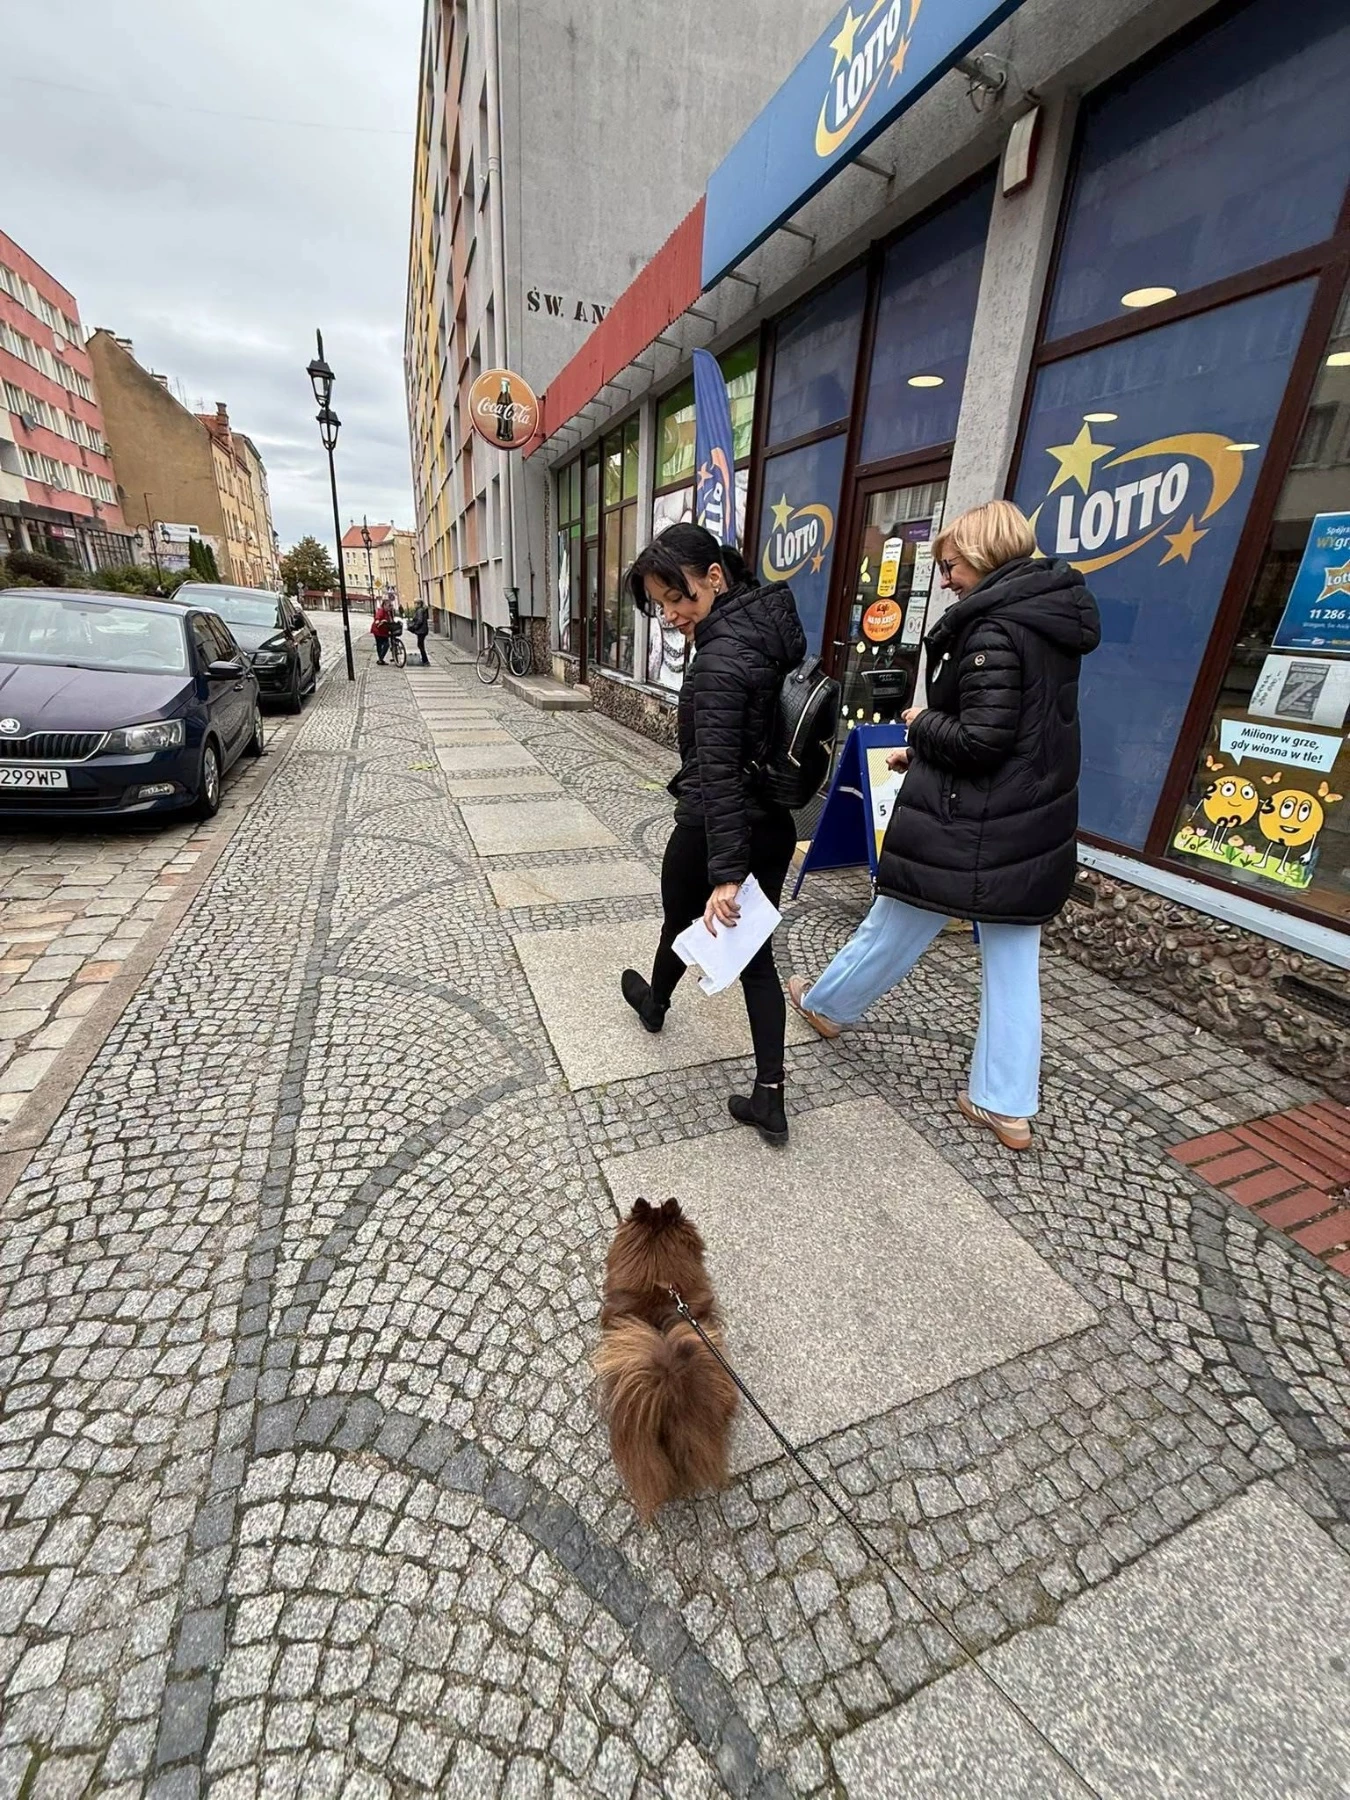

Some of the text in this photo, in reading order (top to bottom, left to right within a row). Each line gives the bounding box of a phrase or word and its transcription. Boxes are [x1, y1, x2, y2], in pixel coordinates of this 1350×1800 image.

[836, 0, 901, 127] LOTTO
[527, 286, 612, 325] ŚW. AN
[1055, 462, 1189, 554] LOTTO
[776, 518, 818, 567] LOTTO
[1316, 536, 1350, 551] WYgr
[1310, 609, 1322, 619] 11
[1322, 609, 1346, 620] 286
[1241, 727, 1320, 750] Miliony w grze,
[1230, 740, 1323, 764] gdy wiosna w tle!
[0, 769, 62, 786] 299WP
[879, 805, 887, 816] 5
